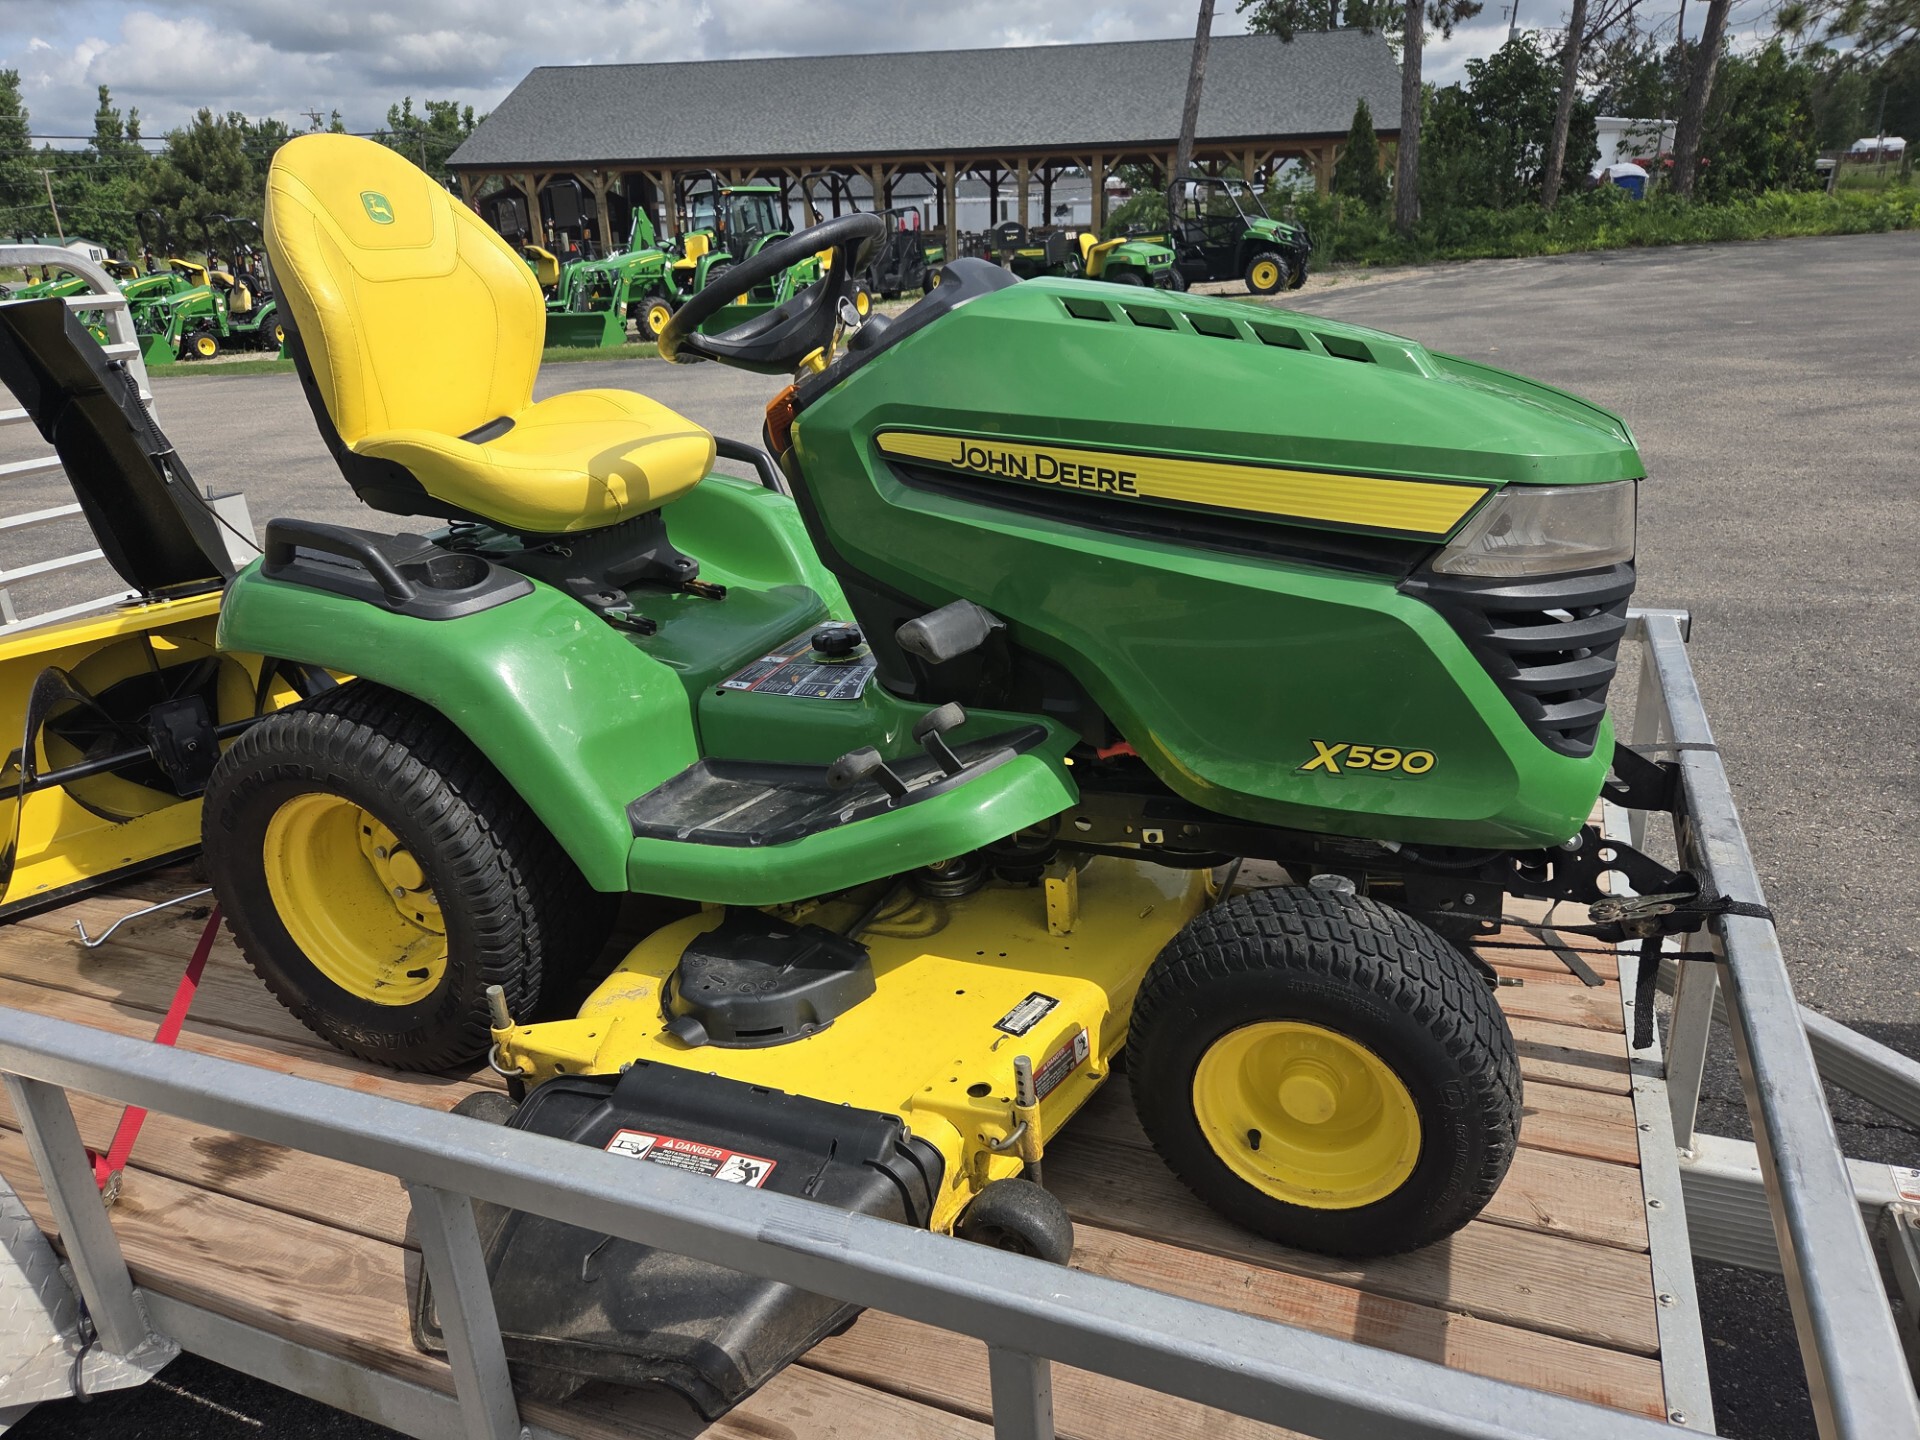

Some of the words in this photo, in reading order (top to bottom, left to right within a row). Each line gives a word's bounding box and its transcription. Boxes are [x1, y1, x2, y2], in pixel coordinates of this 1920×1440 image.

[951, 441, 1029, 477] JOHN
[1034, 454, 1138, 494] DEERE
[1299, 740, 1436, 774] X590
[674, 1141, 723, 1158] DANGER
